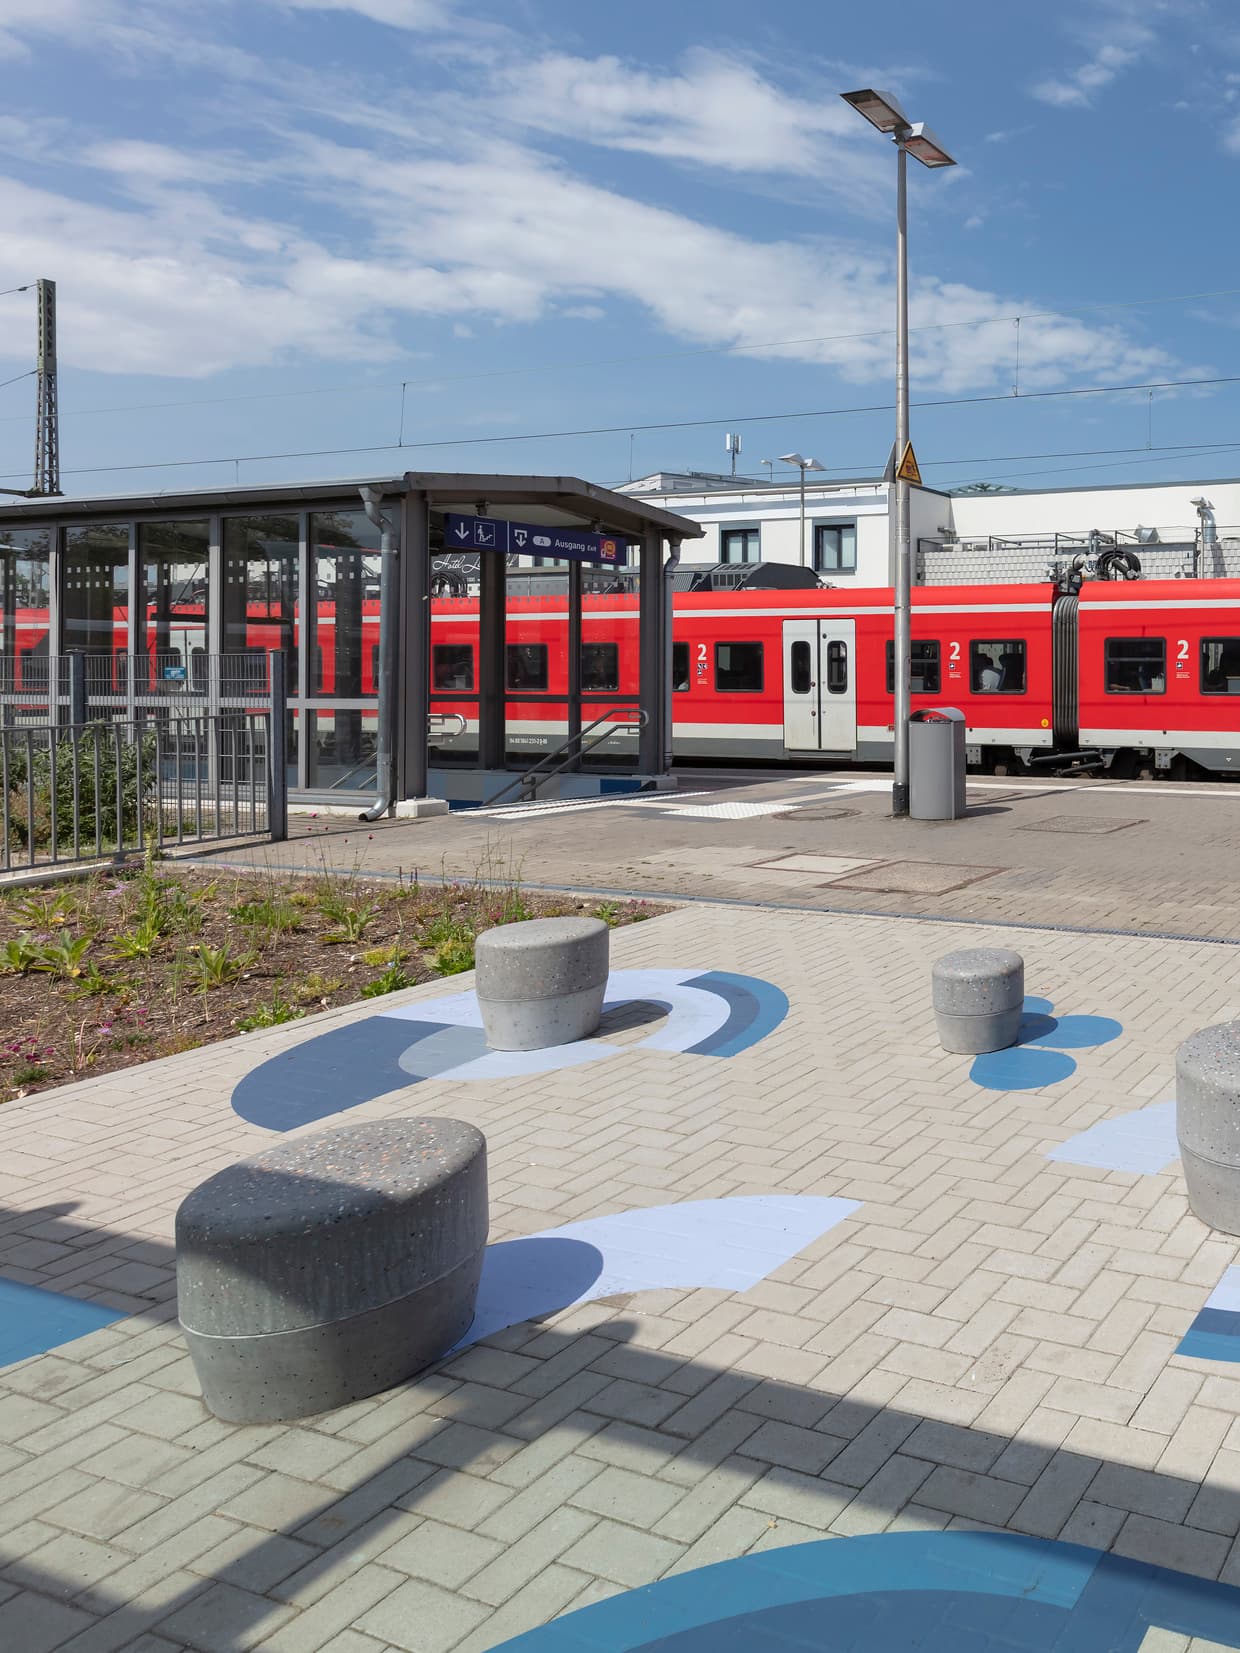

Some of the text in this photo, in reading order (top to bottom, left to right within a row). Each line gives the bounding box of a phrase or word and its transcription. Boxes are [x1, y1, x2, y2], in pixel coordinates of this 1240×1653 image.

[555, 539, 585, 552] Ausgang
[432, 553, 465, 570] Hotel
[697, 643, 707, 661] 2
[950, 641, 960, 660] 2
[1177, 640, 1189, 659] 2
